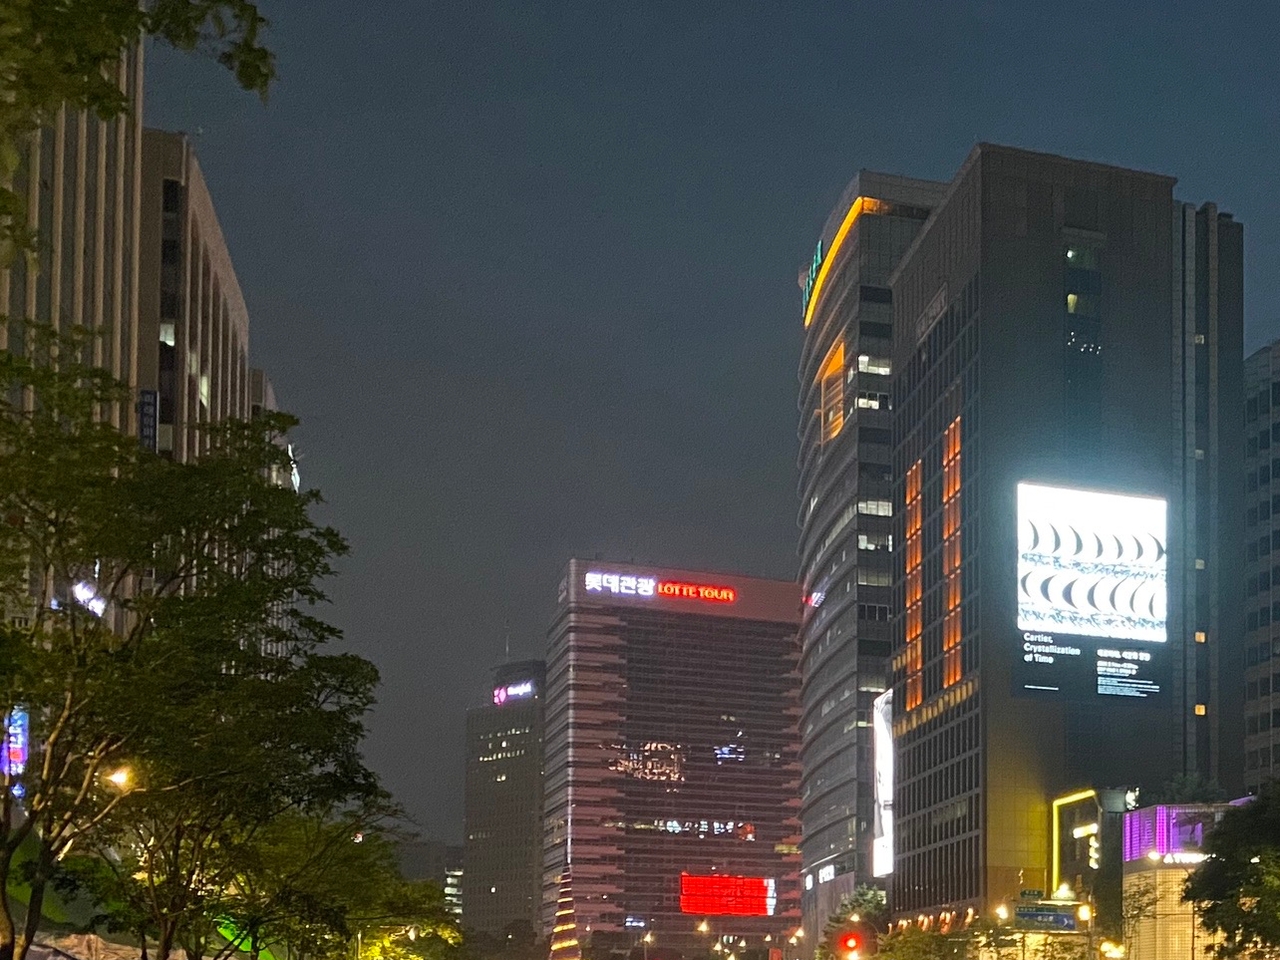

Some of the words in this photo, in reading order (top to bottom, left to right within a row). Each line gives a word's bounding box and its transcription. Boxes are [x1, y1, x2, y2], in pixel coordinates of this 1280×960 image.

[585, 572, 656, 596] 롯데관광
[658, 582, 698, 597] LOTTE
[698, 586, 735, 601] TOUR
[1023, 642, 1081, 656] Crystallization
[1023, 653, 1033, 662] of
[1034, 653, 1054, 664] Time
